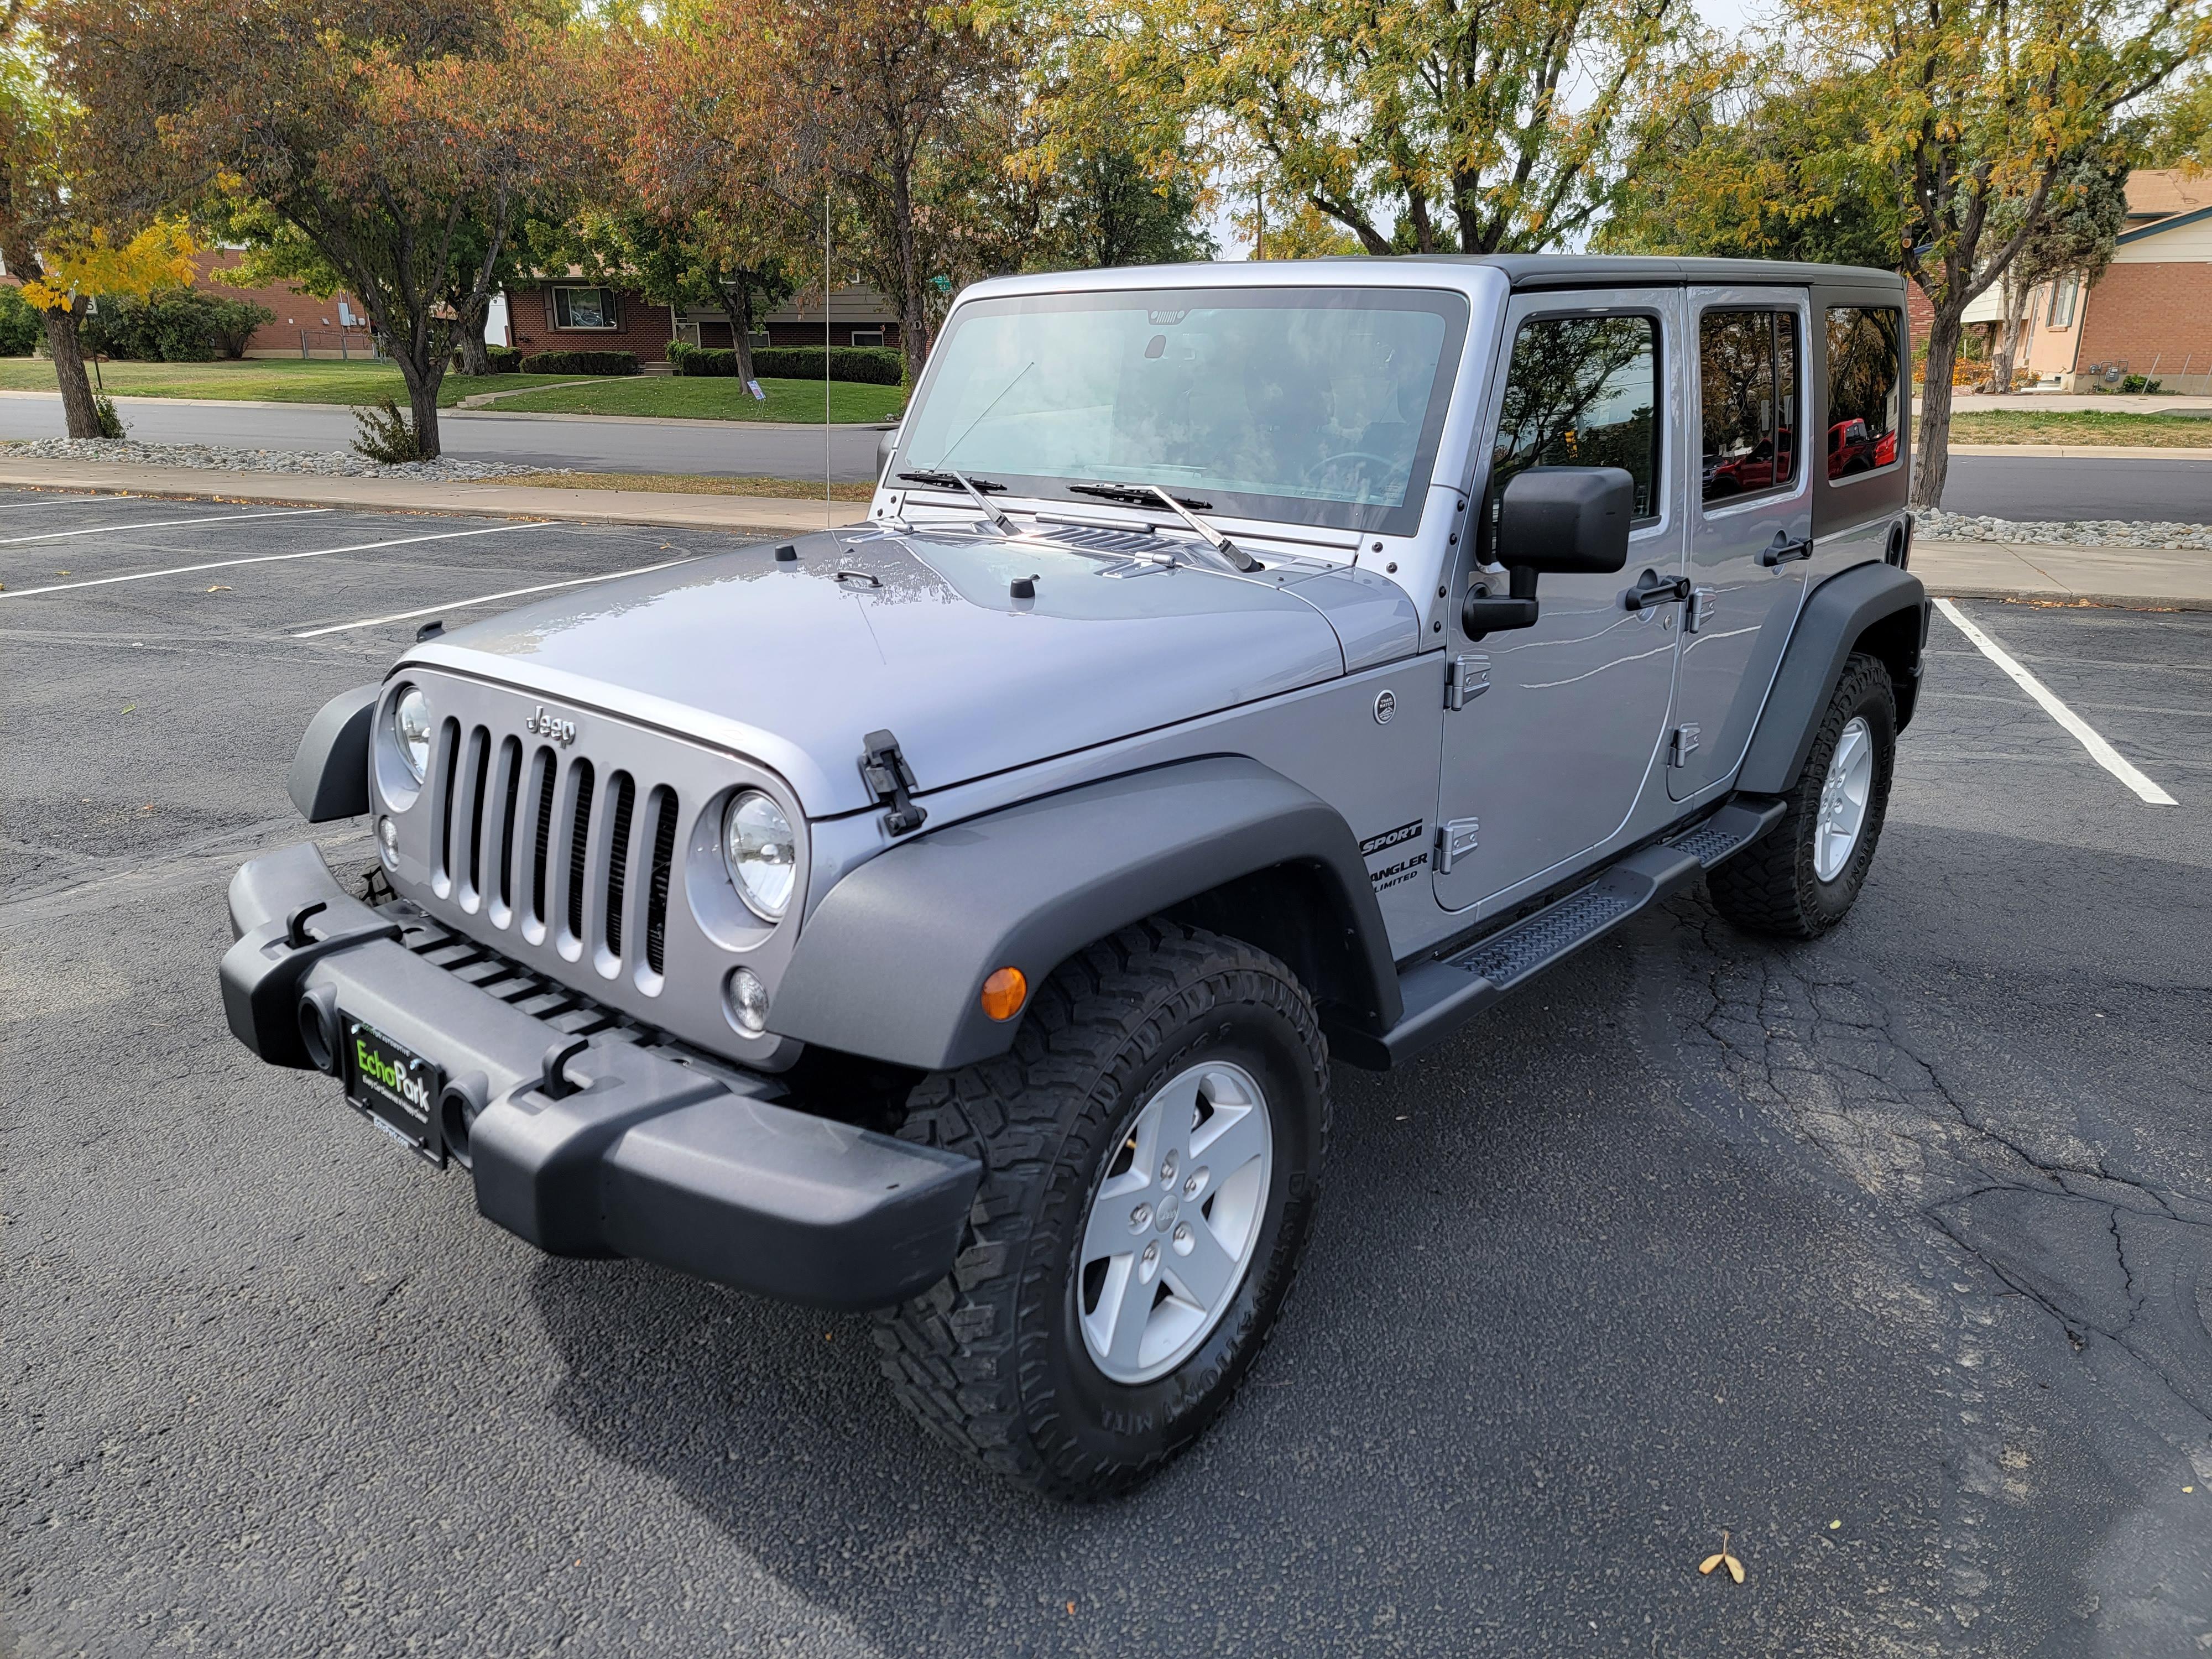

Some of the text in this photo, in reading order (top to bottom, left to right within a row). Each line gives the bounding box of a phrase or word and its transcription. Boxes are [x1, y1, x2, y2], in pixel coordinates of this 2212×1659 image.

[526, 706, 576, 749] Jeep
[1361, 823, 1423, 854] SPORT
[1370, 853, 1427, 883] ANGLER
[1374, 871, 1418, 894] LIMITED
[356, 1039, 430, 1112] EchoPark
